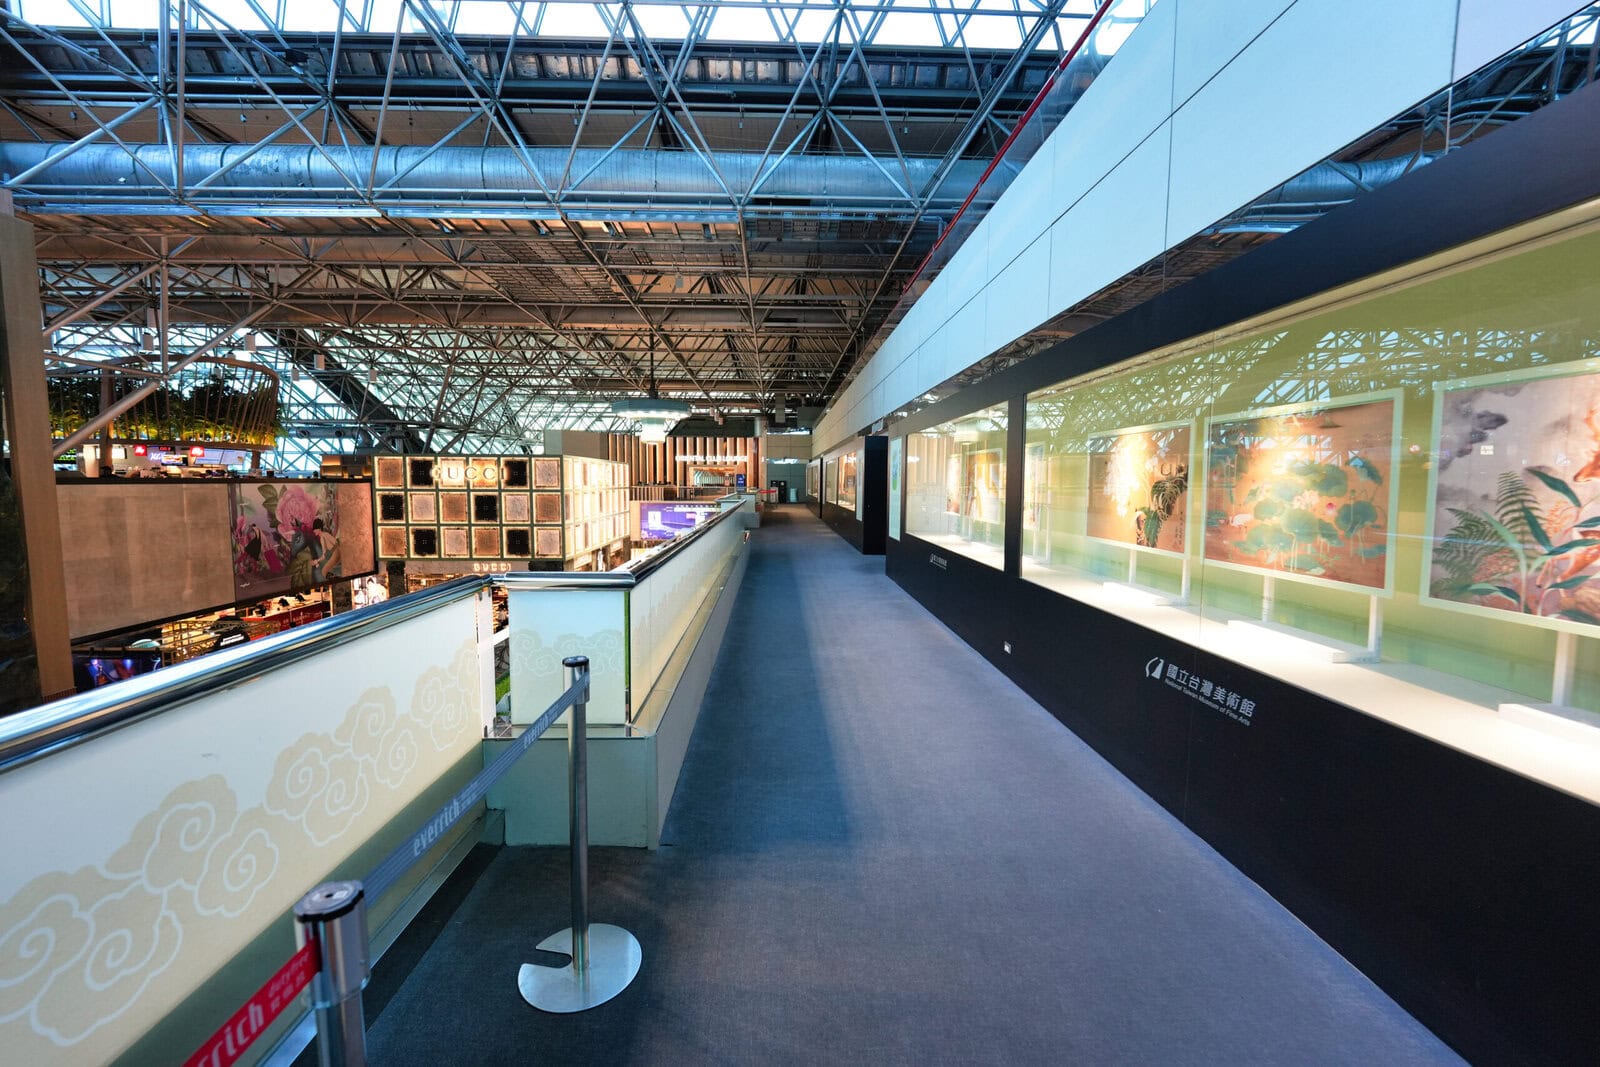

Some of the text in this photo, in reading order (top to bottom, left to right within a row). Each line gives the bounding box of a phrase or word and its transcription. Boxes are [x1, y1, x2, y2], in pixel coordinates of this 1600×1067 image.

[432, 467, 505, 480] GUCCI
[474, 563, 511, 572] GUCCI
[1166, 664, 1255, 717] 國立台灣美術館
[1166, 679, 1182, 691] National
[1182, 687, 1198, 699] Taiwan
[1198, 695, 1219, 710] Museum
[1226, 709, 1238, 720] Fine
[1238, 716, 1251, 727] Arts
[412, 799, 460, 857] everrich
